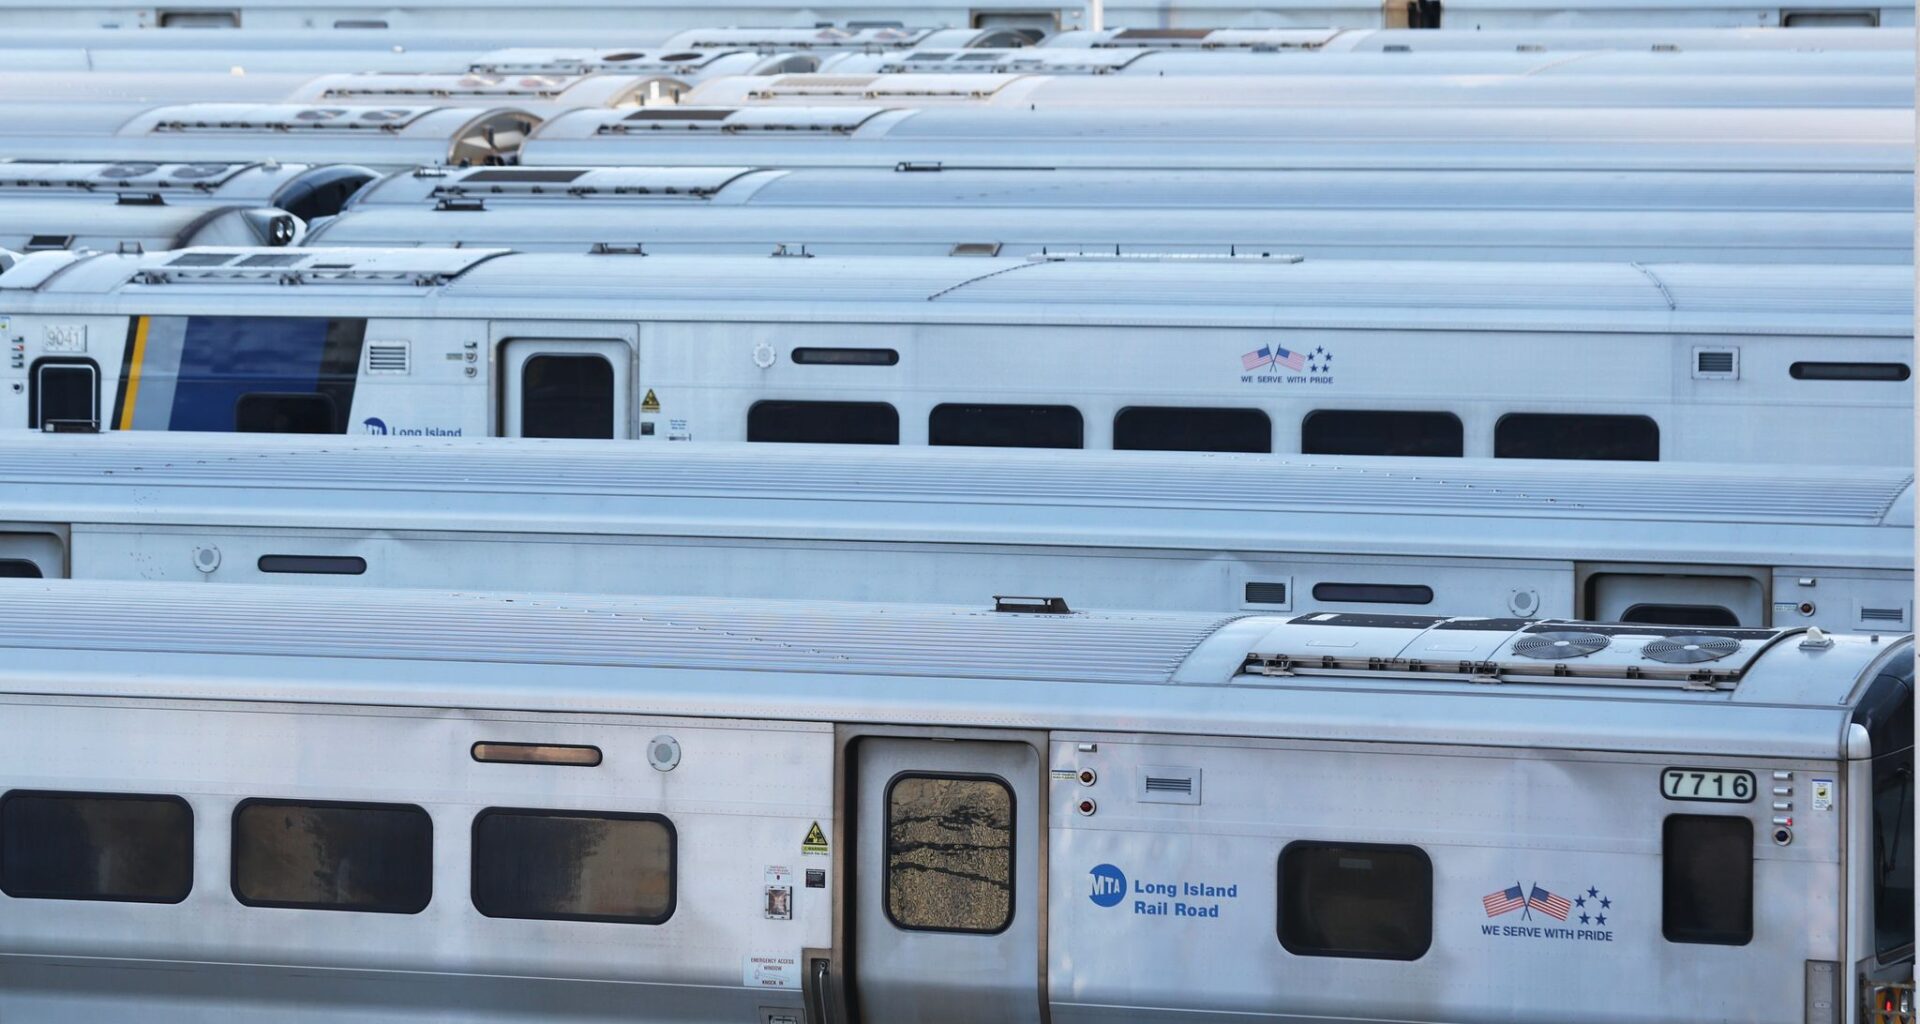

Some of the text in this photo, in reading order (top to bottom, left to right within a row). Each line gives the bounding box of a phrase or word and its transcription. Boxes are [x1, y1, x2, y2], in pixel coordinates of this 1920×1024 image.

[47, 329, 79, 346] 9041
[1310, 376, 1334, 384] PRIDE
[425, 427, 462, 437] Island
[1669, 773, 1748, 798] 7716
[1088, 873, 1121, 896] MTA
[1135, 880, 1238, 898] Long Island
[1135, 901, 1219, 918] Rail Road
[1481, 925, 1613, 941] WE SERVE WITH PRIDE
